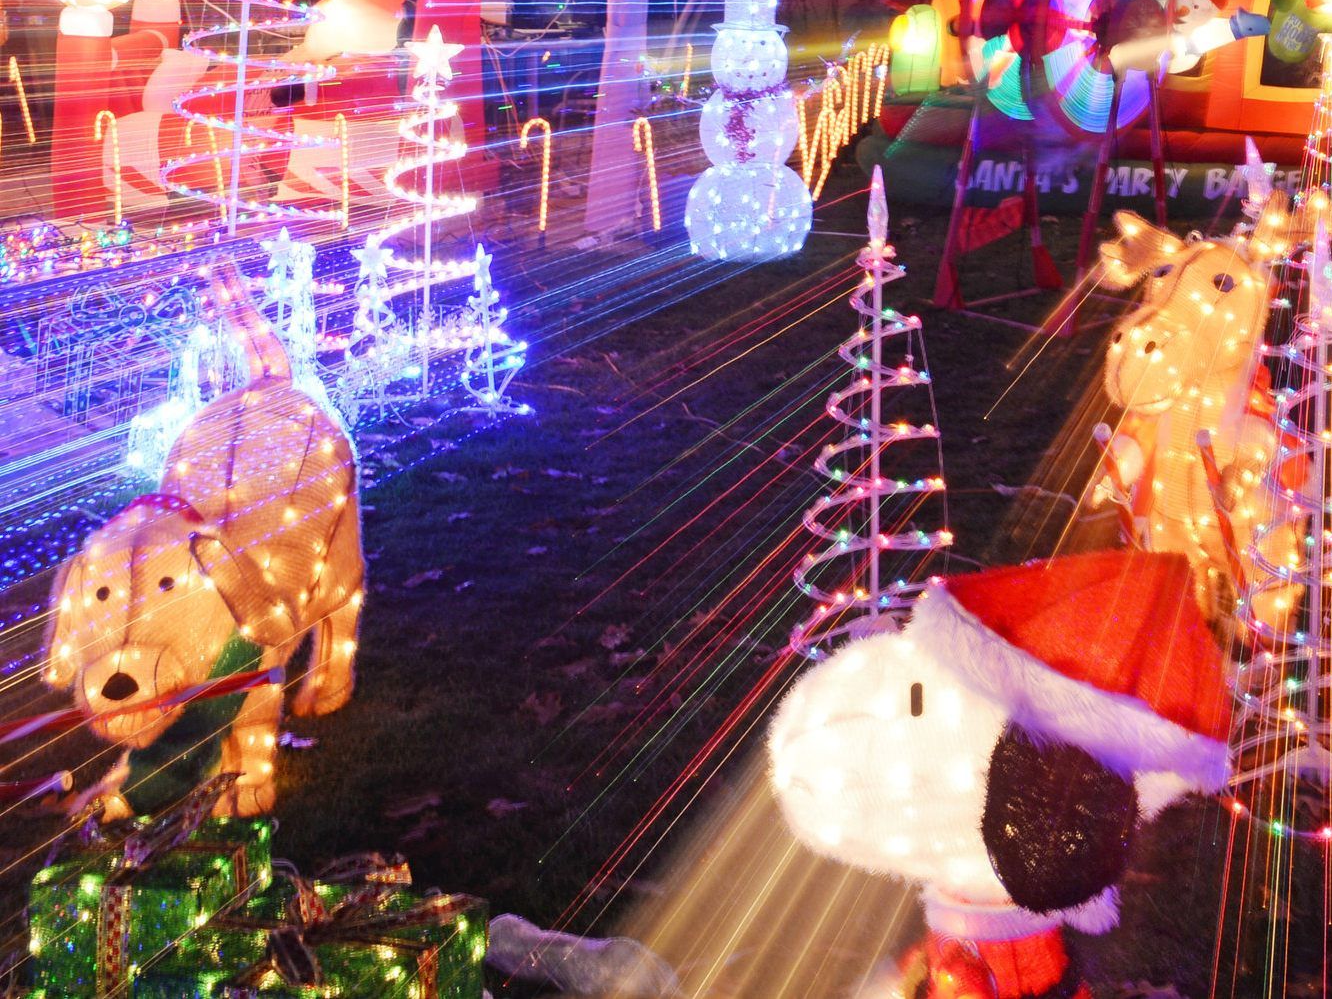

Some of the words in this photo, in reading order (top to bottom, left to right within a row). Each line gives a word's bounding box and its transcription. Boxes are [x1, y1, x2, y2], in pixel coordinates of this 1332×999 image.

[956, 160, 1080, 194] ANTAS
[1103, 166, 1189, 199] ARY
[1203, 168, 1302, 200] BAGE
